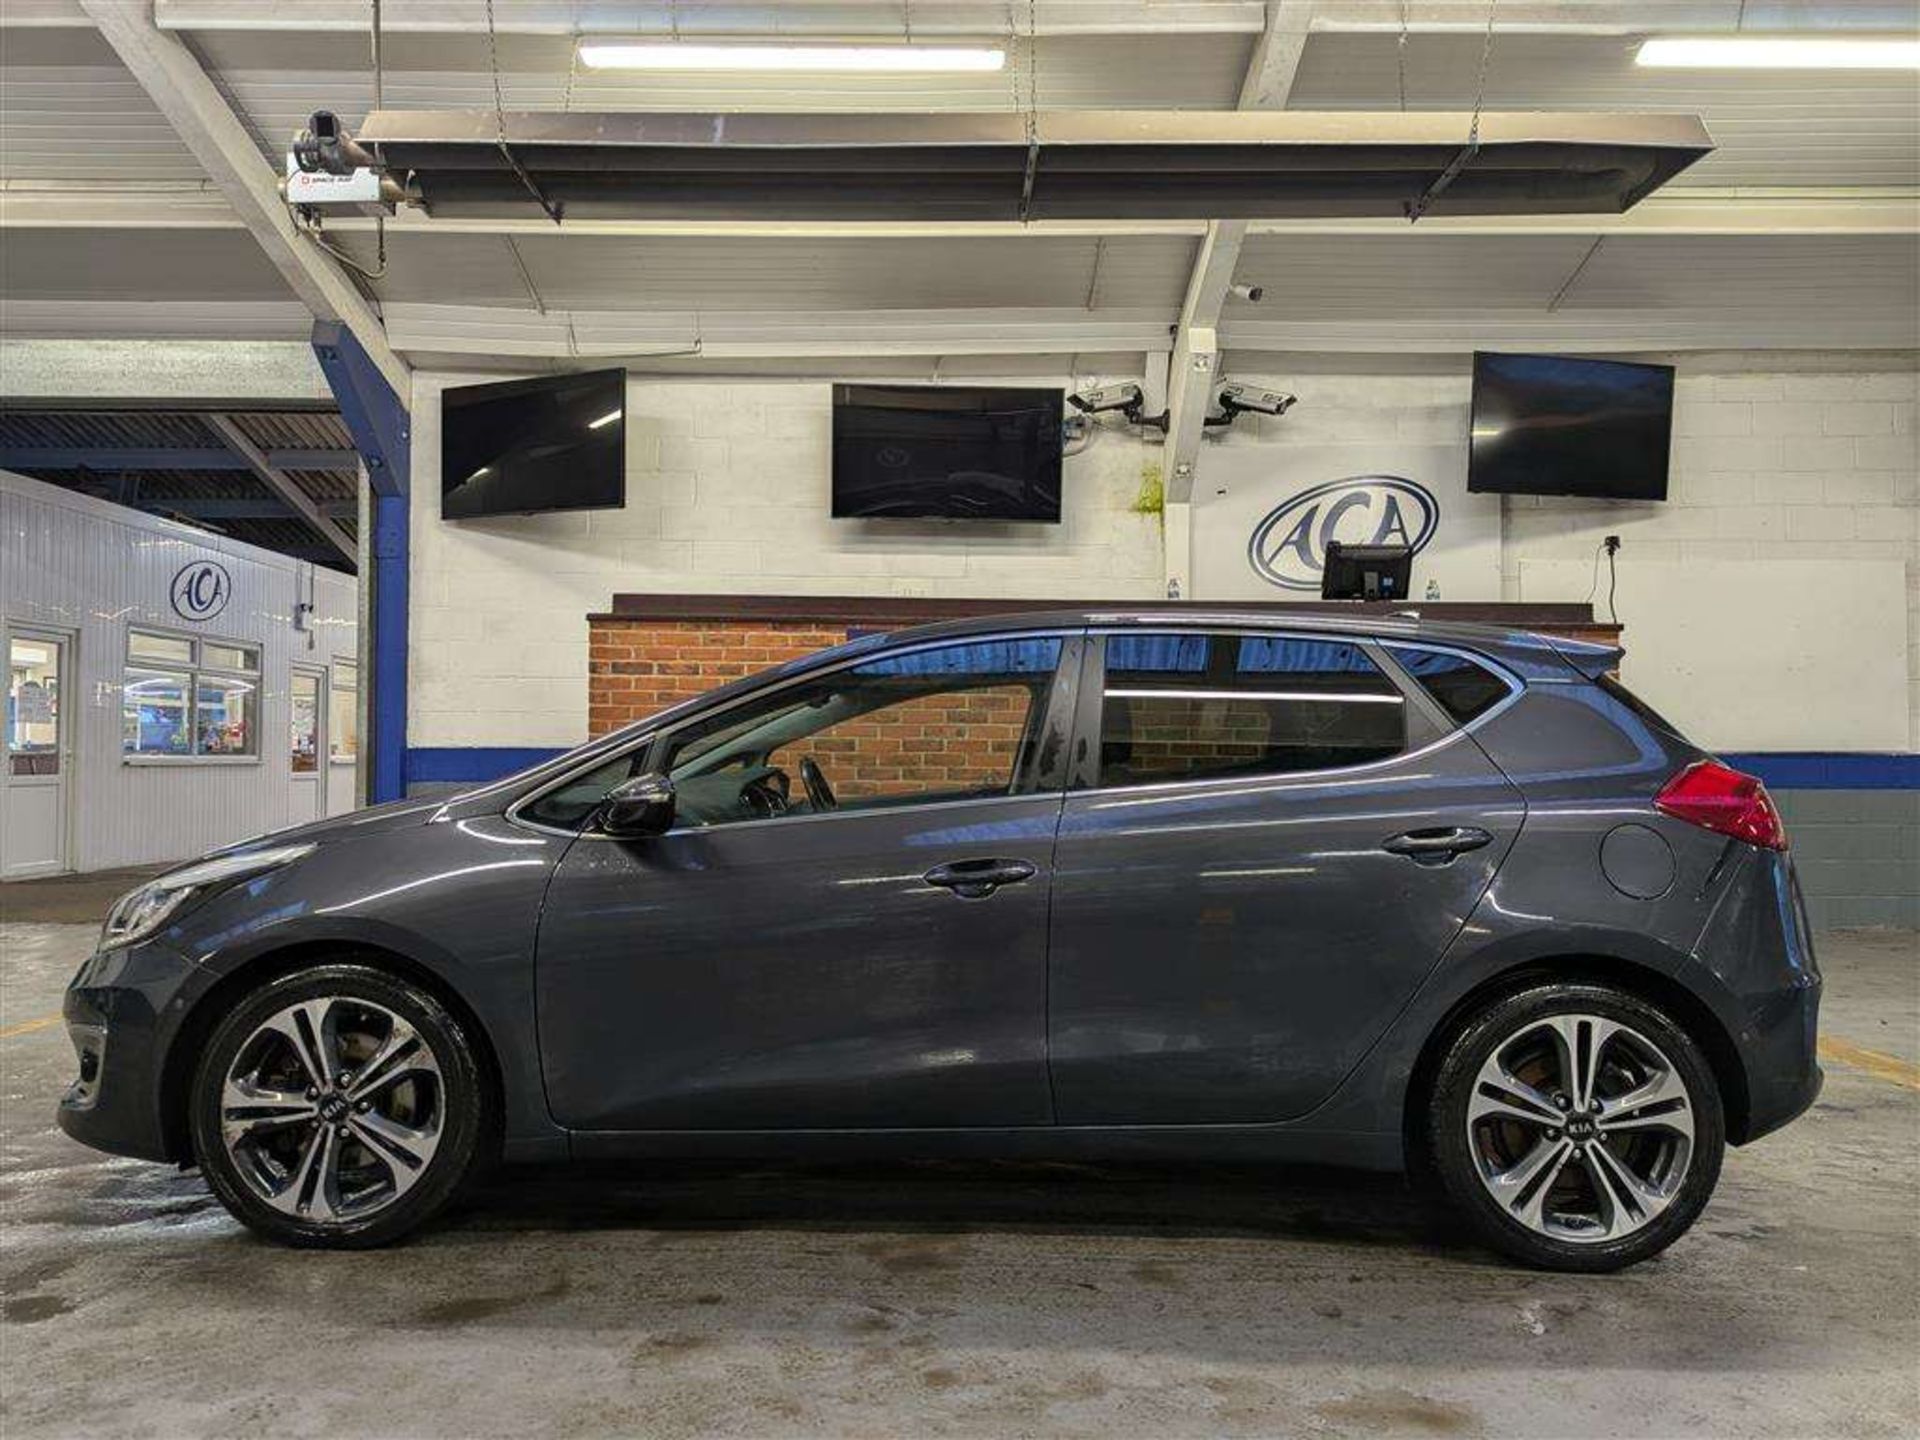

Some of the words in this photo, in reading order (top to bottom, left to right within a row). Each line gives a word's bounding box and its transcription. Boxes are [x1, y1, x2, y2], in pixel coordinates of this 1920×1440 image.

[1265, 491, 1410, 571] ACA
[175, 568, 224, 613] ACA
[321, 1100, 346, 1119] KIA
[1568, 1122, 1593, 1134] KIA
